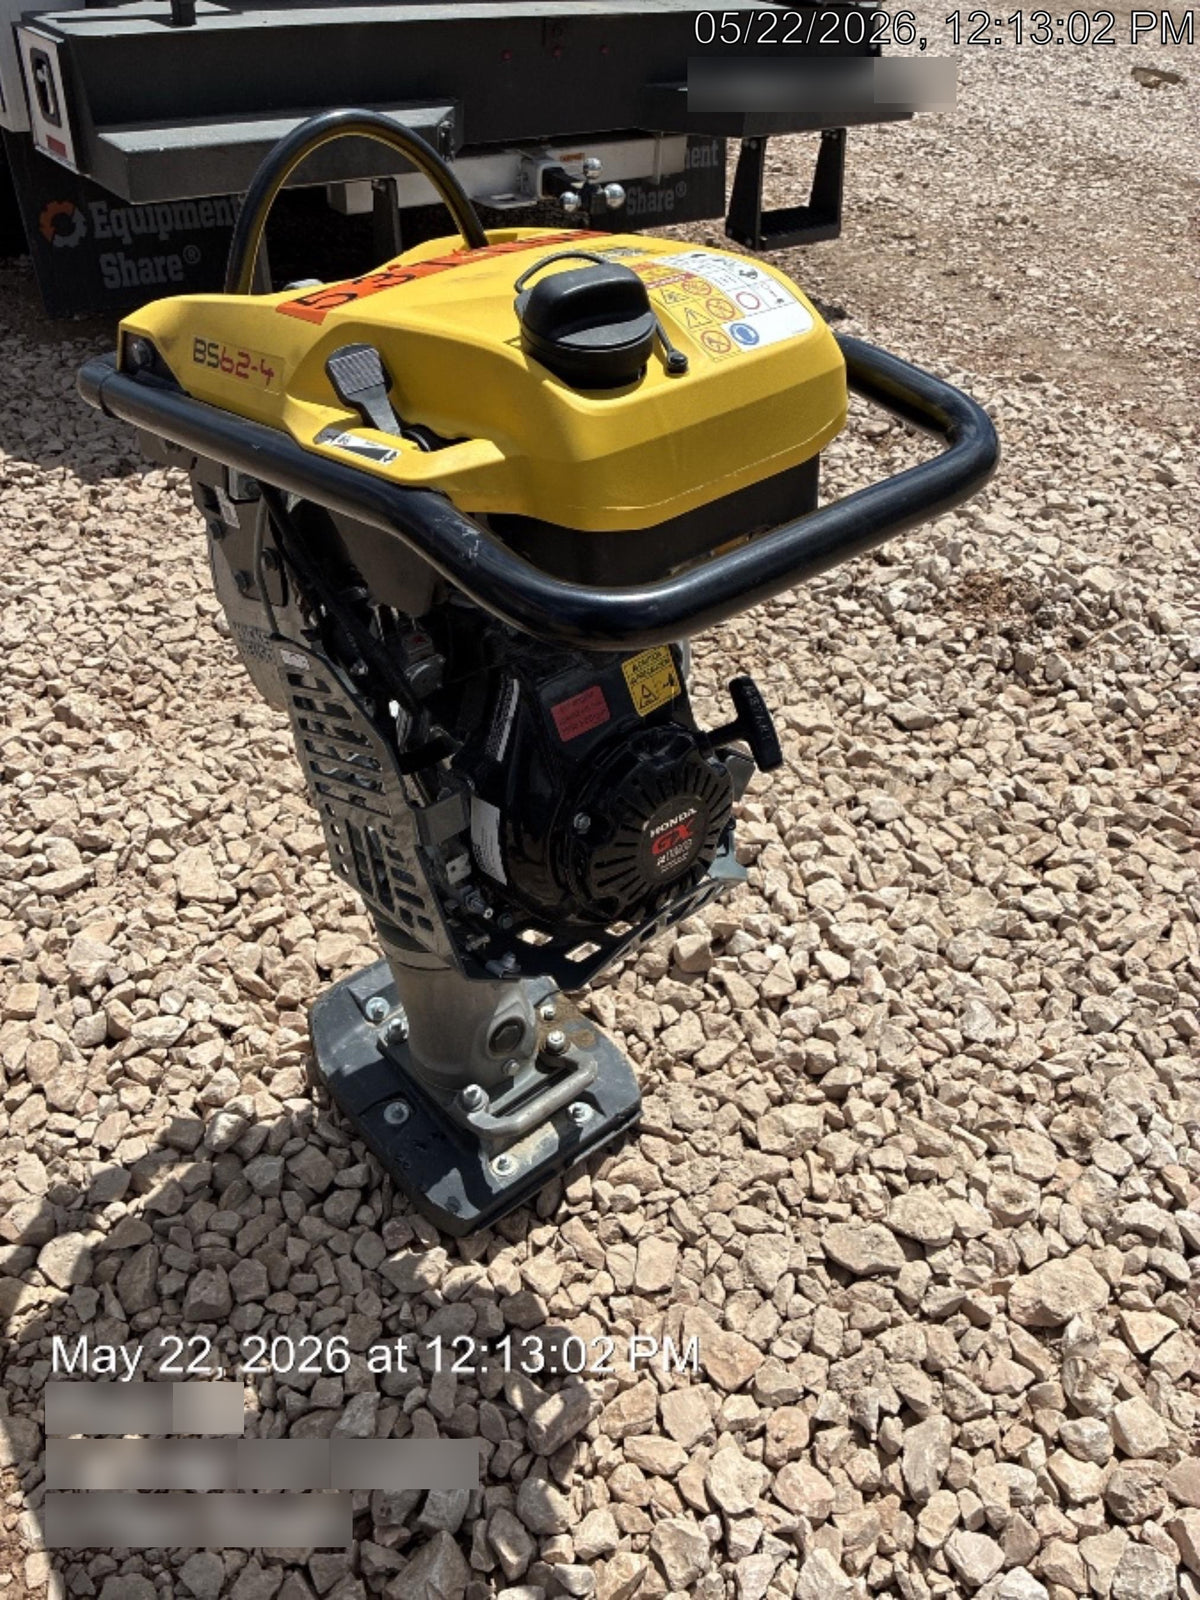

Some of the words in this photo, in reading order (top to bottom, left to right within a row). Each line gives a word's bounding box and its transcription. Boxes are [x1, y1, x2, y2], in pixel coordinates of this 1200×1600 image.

[88, 196, 240, 245] Equipmen
[193, 337, 275, 386] BS62-4
[650, 808, 697, 838] HONDA
